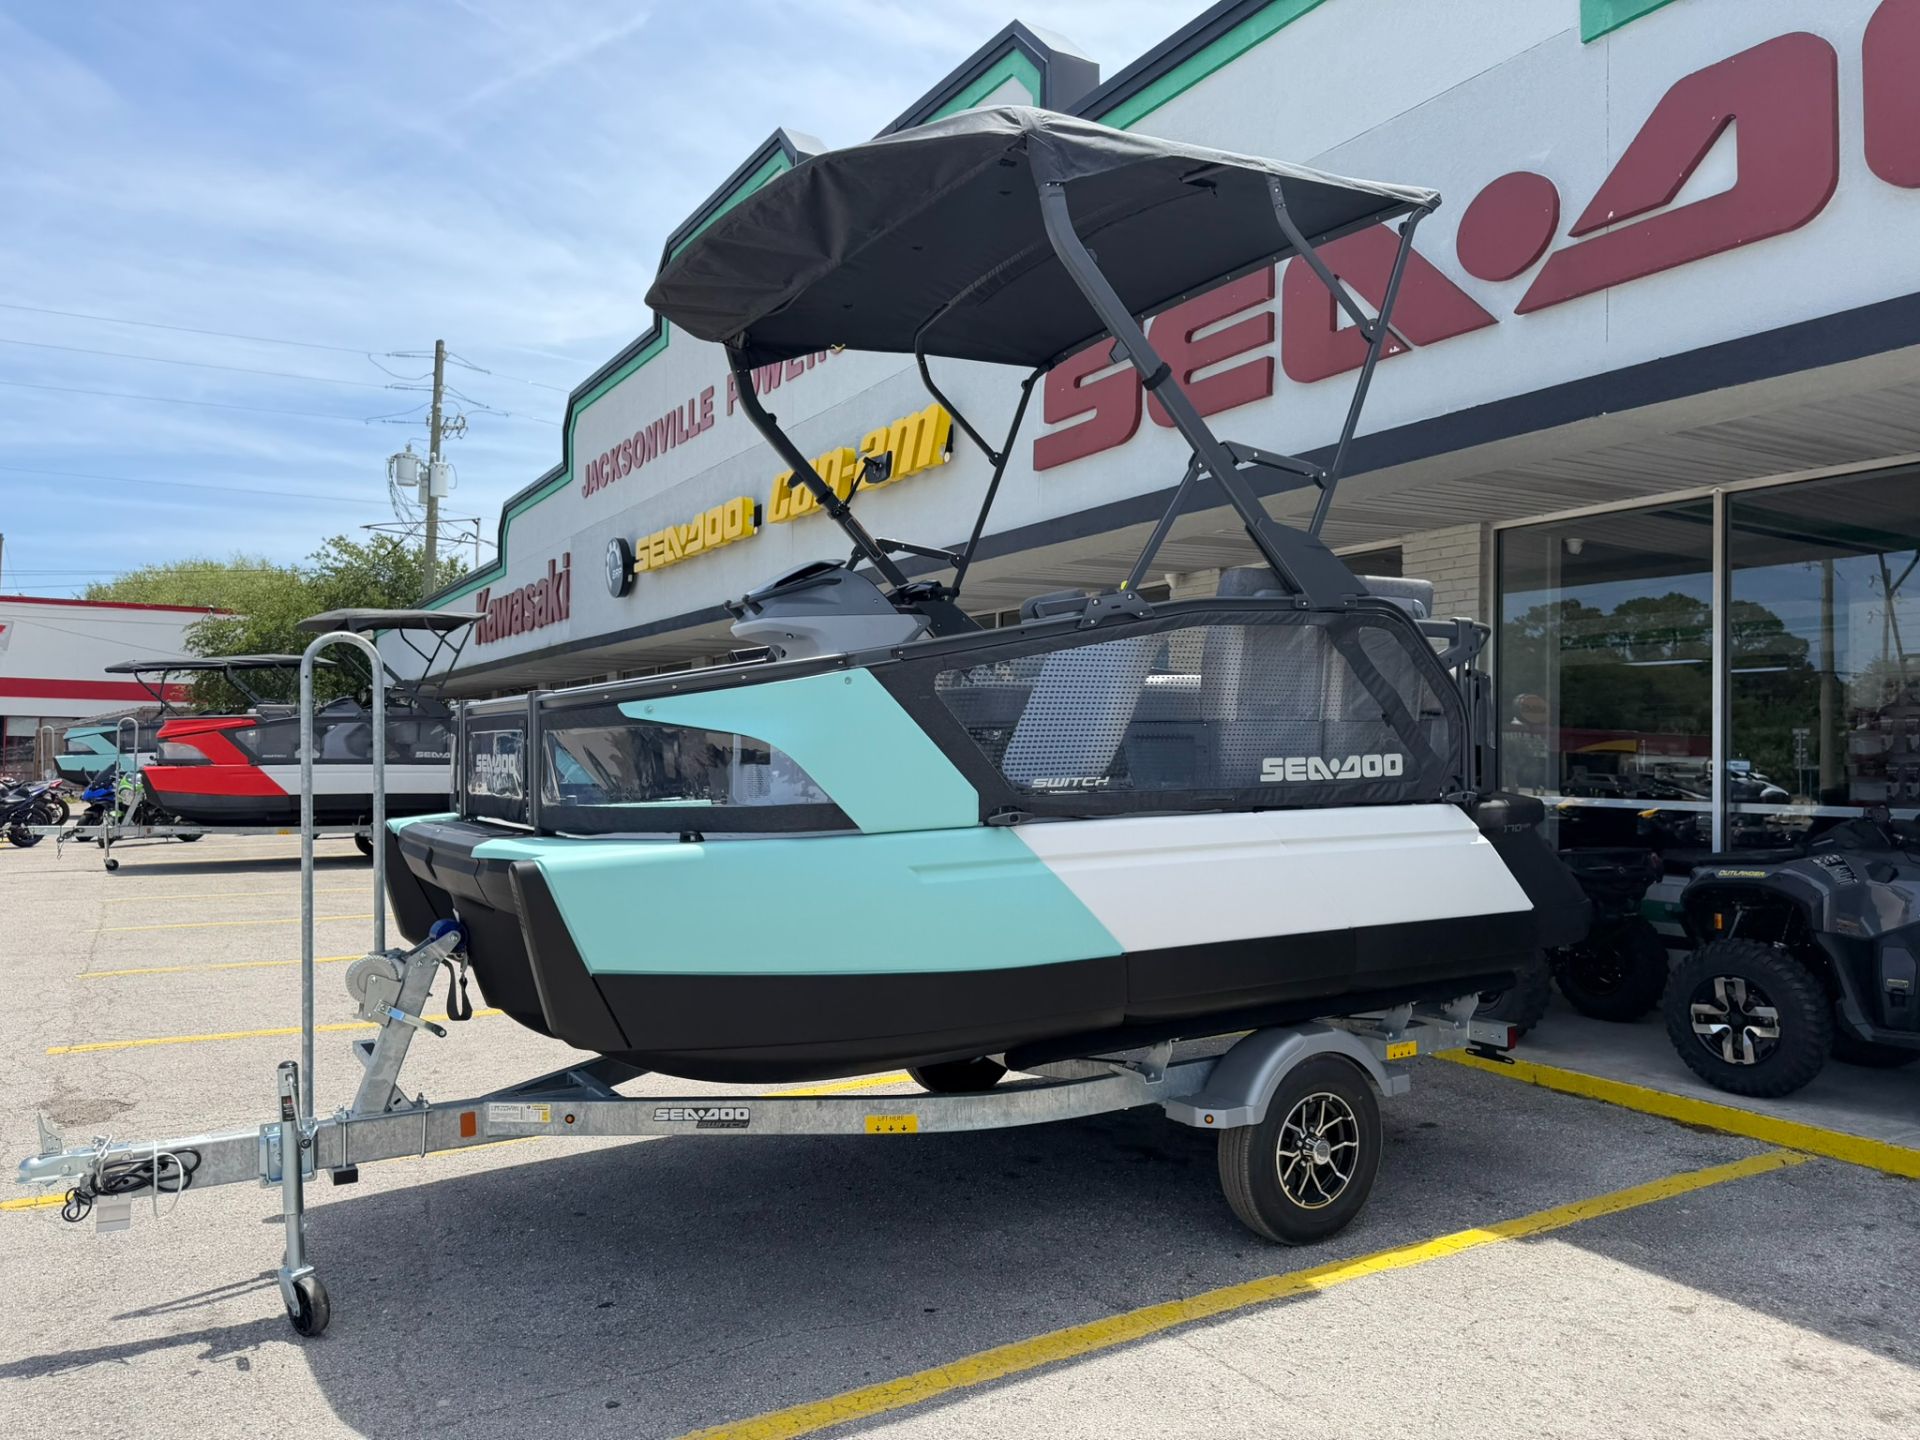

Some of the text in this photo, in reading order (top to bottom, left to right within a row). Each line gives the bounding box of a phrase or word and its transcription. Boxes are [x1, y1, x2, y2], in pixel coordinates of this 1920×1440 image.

[582, 385, 715, 499] JACKSONVILLE
[475, 552, 571, 645] Kawasaki
[1031, 776, 1110, 788] SWITCH
[1718, 869, 1767, 878] OUTLANDER
